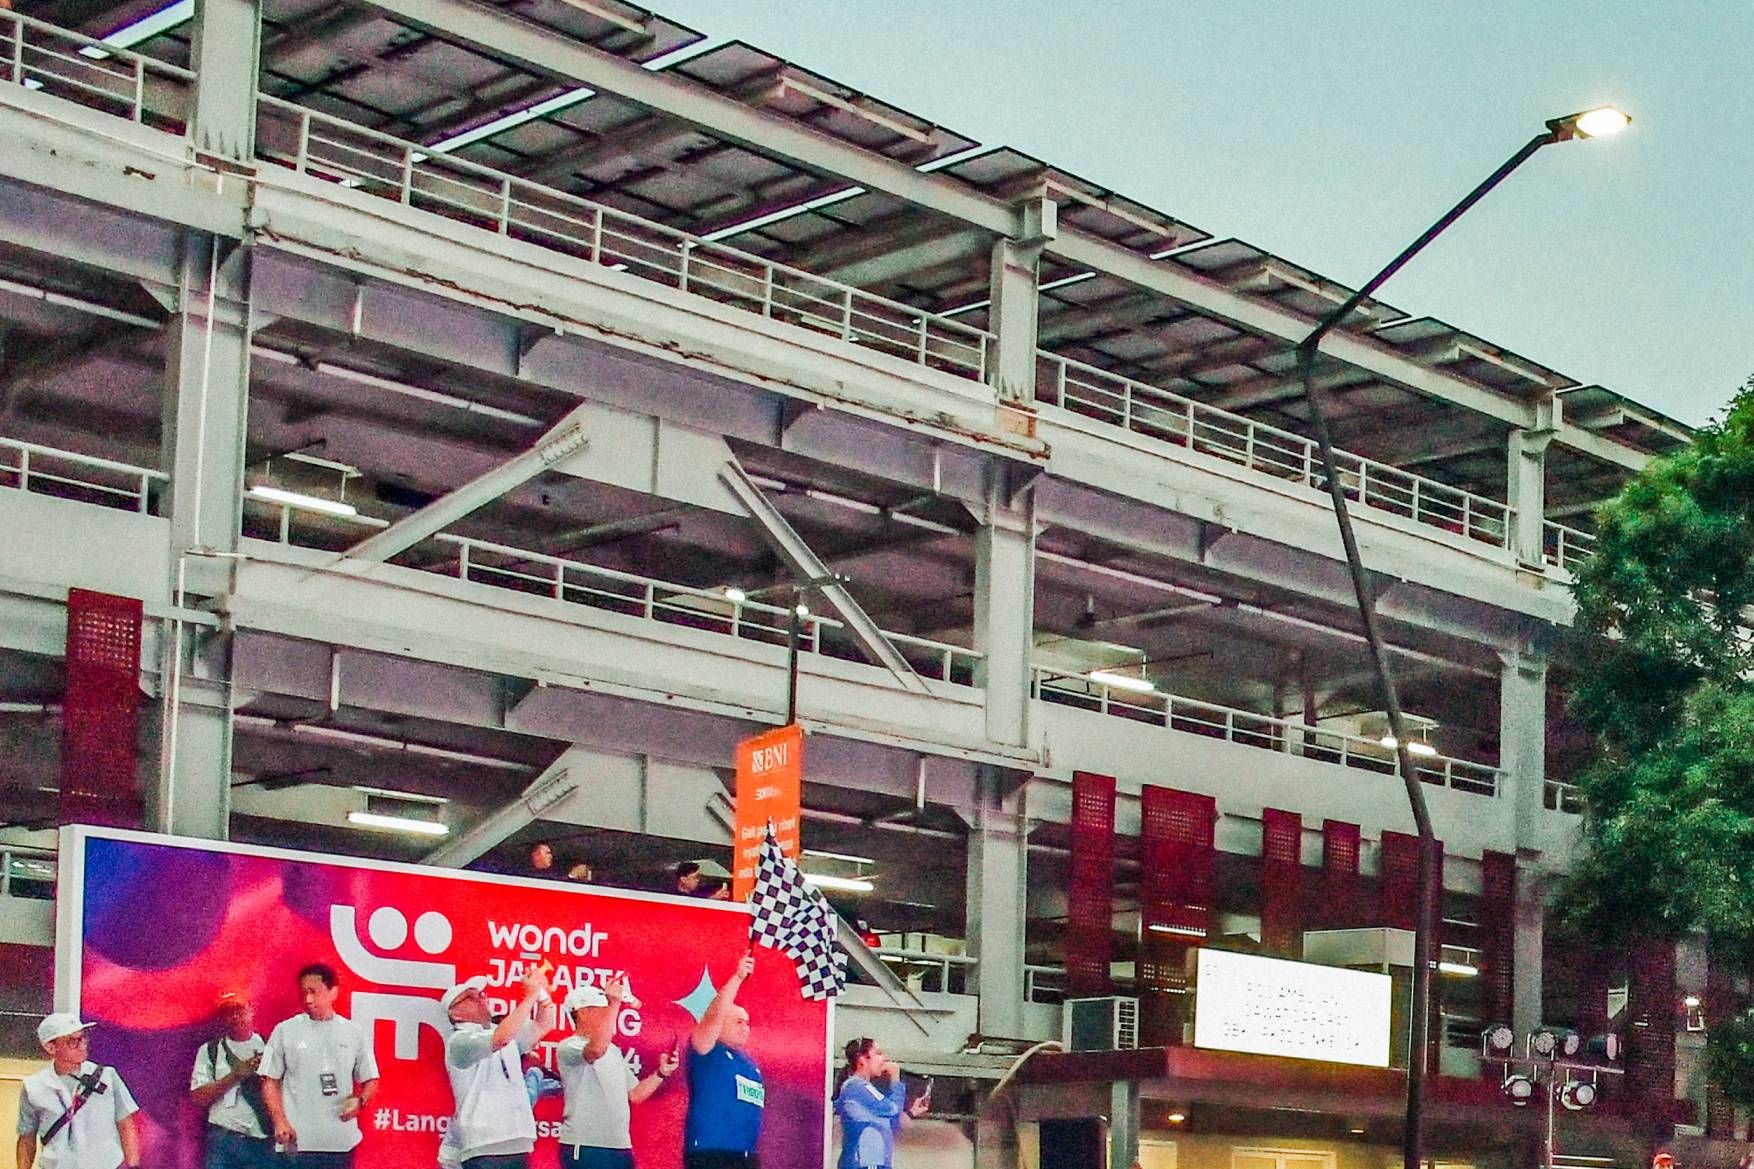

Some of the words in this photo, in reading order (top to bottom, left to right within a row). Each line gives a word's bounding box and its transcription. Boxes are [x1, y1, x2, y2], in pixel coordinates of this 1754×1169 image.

[764, 743, 787, 770] BNI
[488, 920, 608, 957] wondr
[488, 959, 632, 1003] JAARTA
